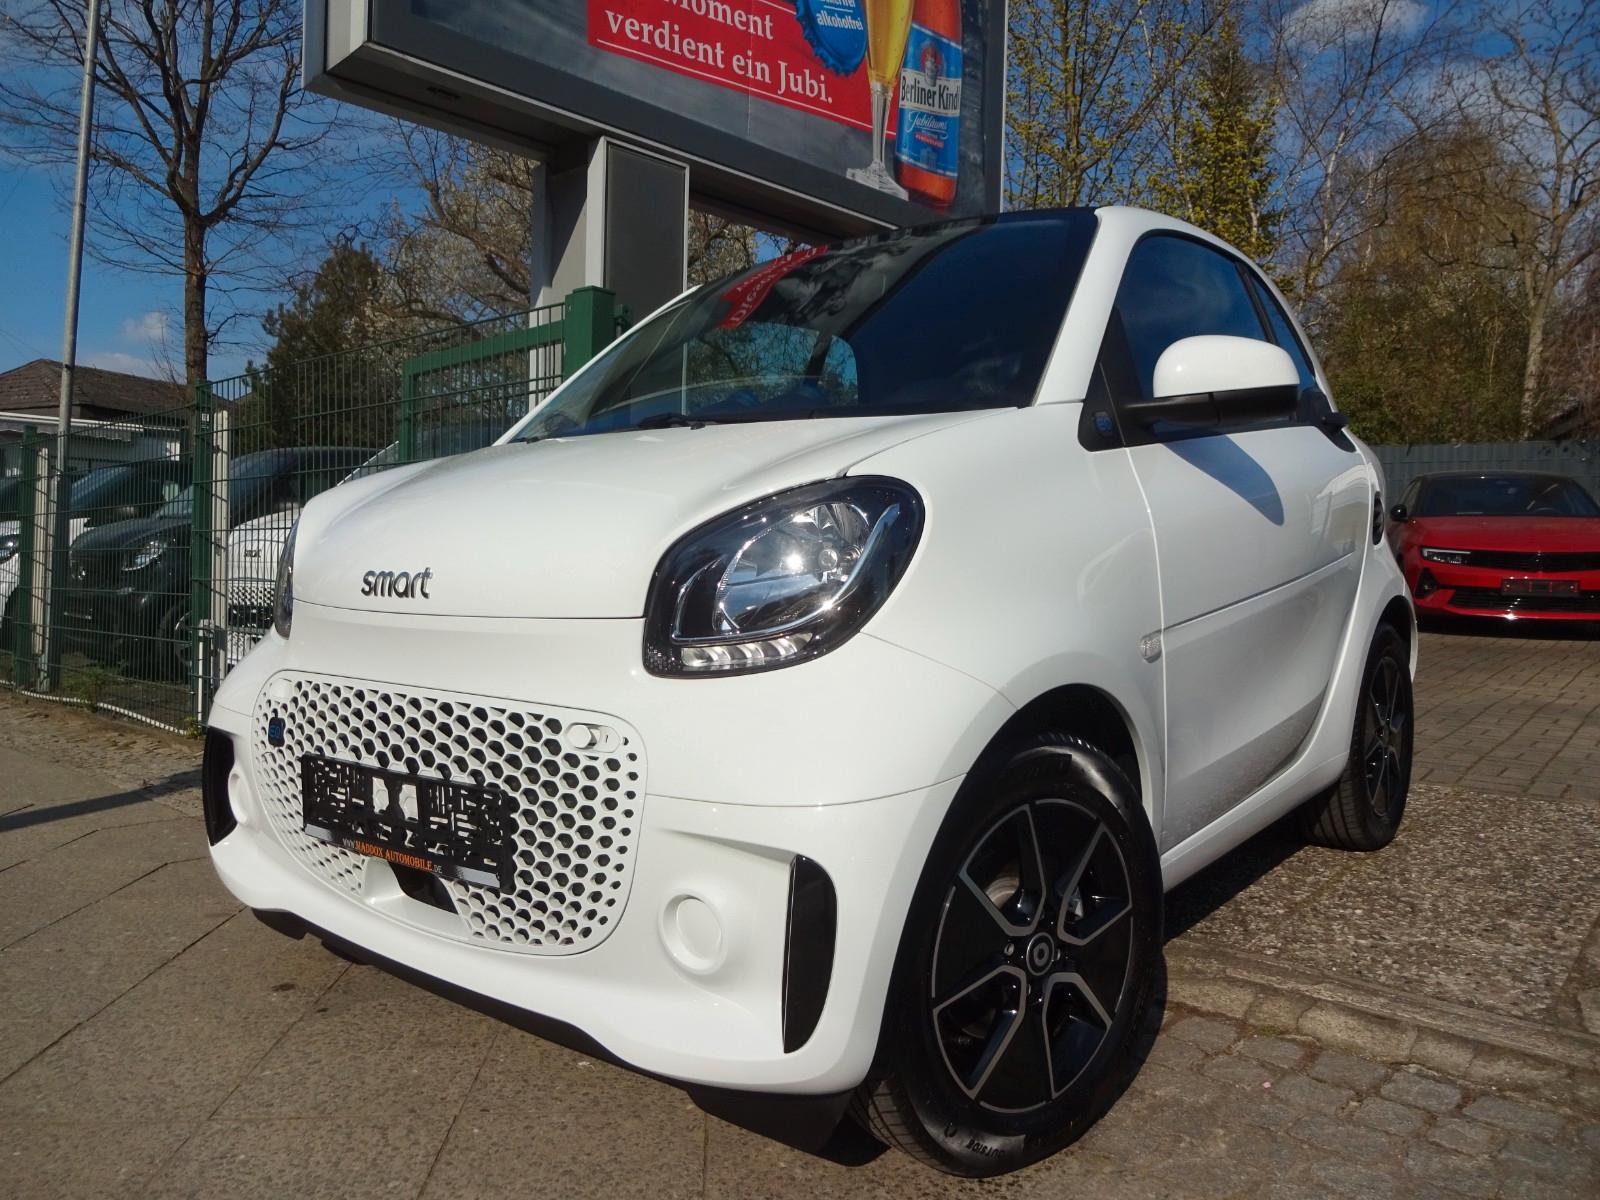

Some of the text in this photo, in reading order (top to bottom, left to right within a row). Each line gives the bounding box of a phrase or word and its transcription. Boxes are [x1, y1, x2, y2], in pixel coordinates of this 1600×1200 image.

[816, 9, 864, 31] alkoholfrei
[605, 10, 833, 104] verdient ein Jubi.
[901, 75, 937, 109] Berliner
[361, 567, 433, 599] smart
